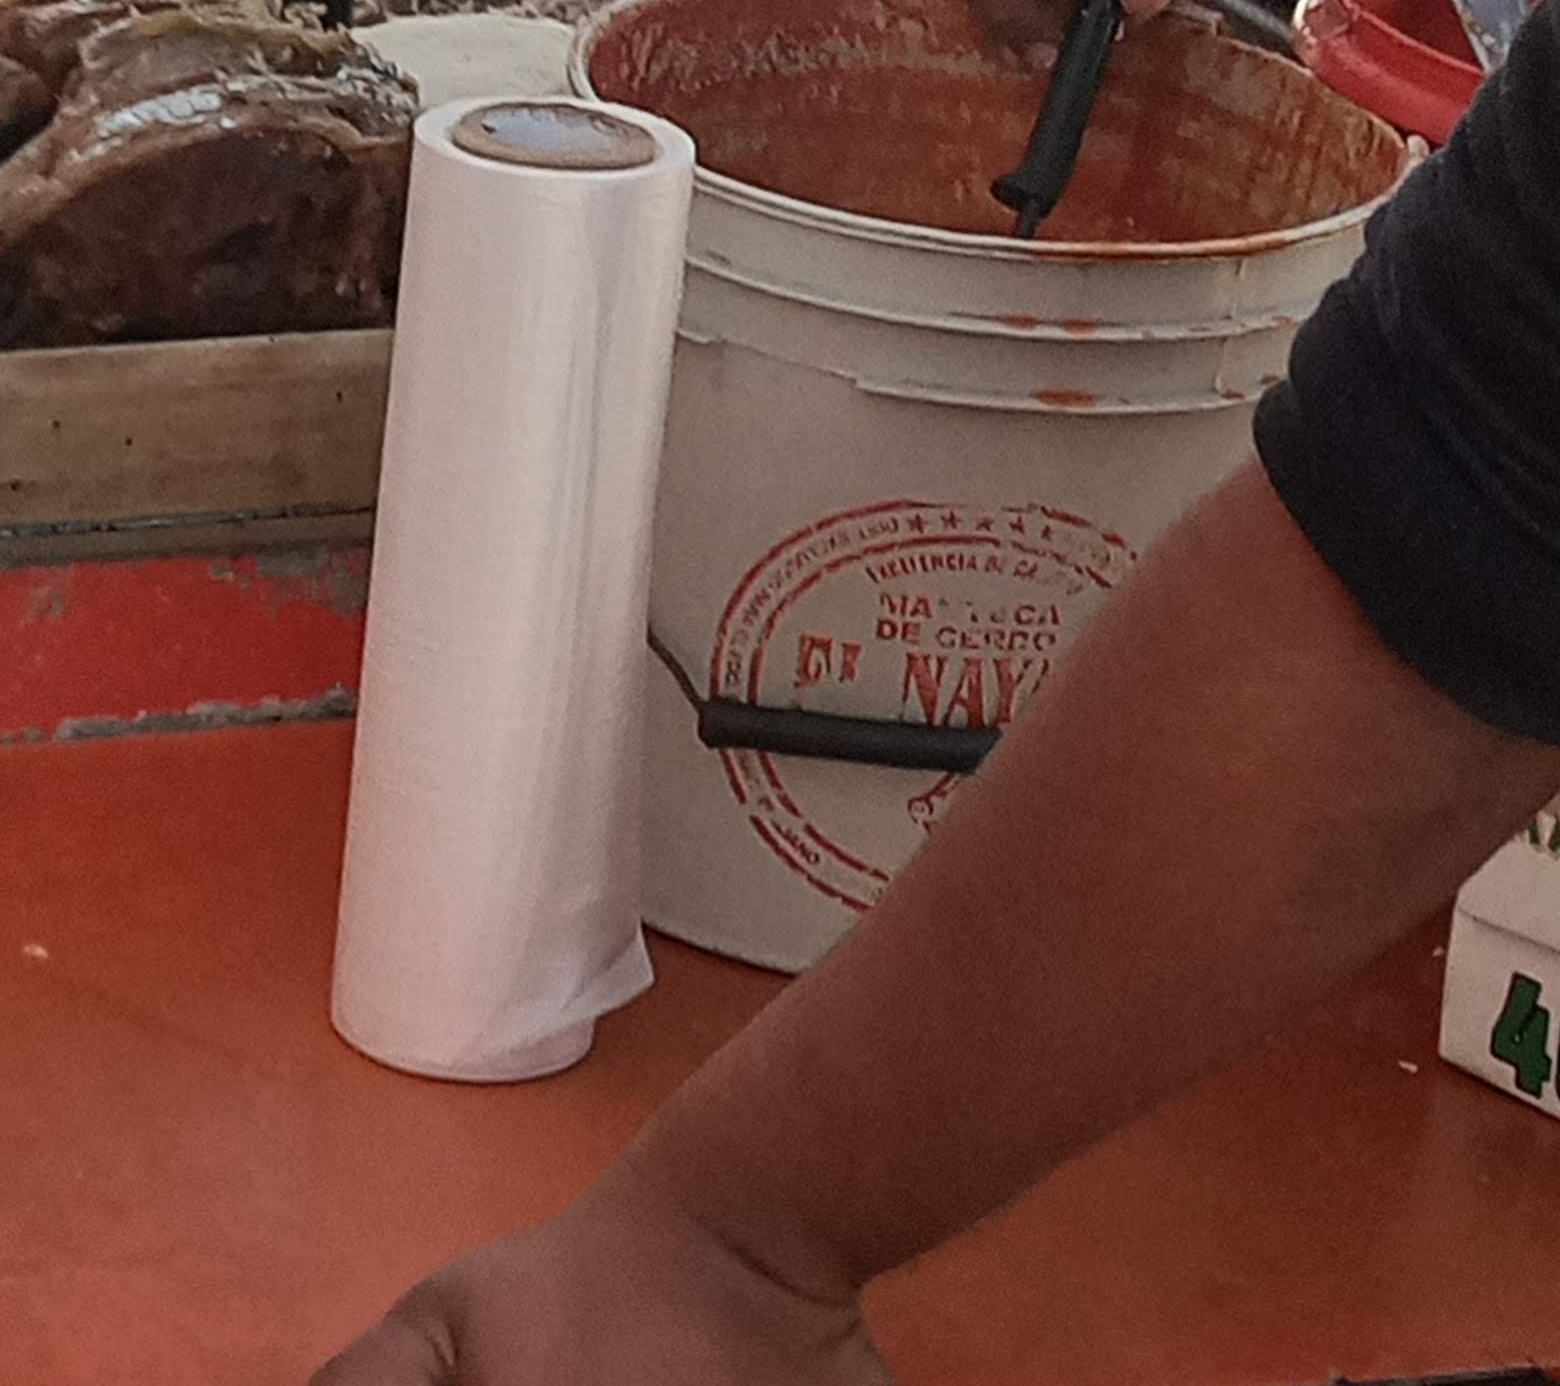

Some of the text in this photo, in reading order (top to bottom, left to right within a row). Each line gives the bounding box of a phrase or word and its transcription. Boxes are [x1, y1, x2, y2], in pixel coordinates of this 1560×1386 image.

[875, 618, 921, 646] DE
[899, 651, 1051, 730] NAY
[1489, 970, 1560, 1101] 4
